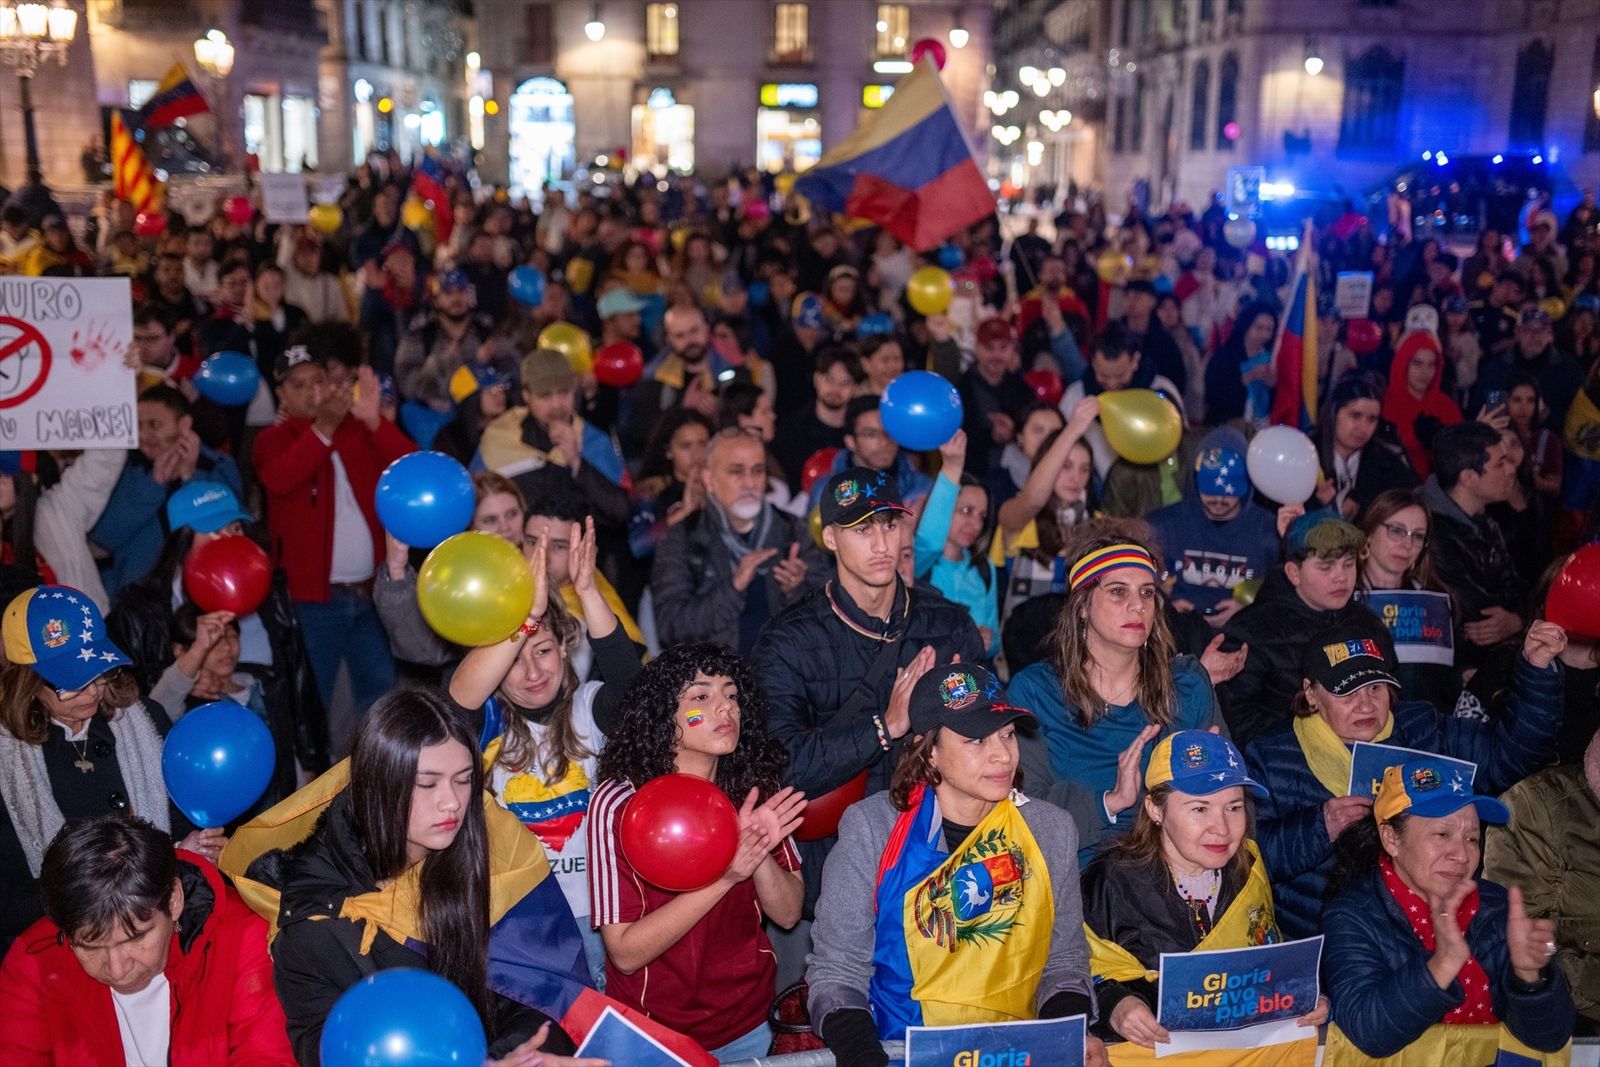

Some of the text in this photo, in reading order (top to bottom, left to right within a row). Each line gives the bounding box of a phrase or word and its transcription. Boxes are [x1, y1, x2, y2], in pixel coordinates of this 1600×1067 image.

[0, 281, 83, 321] URO
[36, 402, 134, 443] MADRE!
[1204, 969, 1271, 991] Gloria
[1187, 987, 1256, 1008] bravo
[1215, 993, 1294, 1022] pueblo
[953, 1048, 1031, 1067] Gloria
